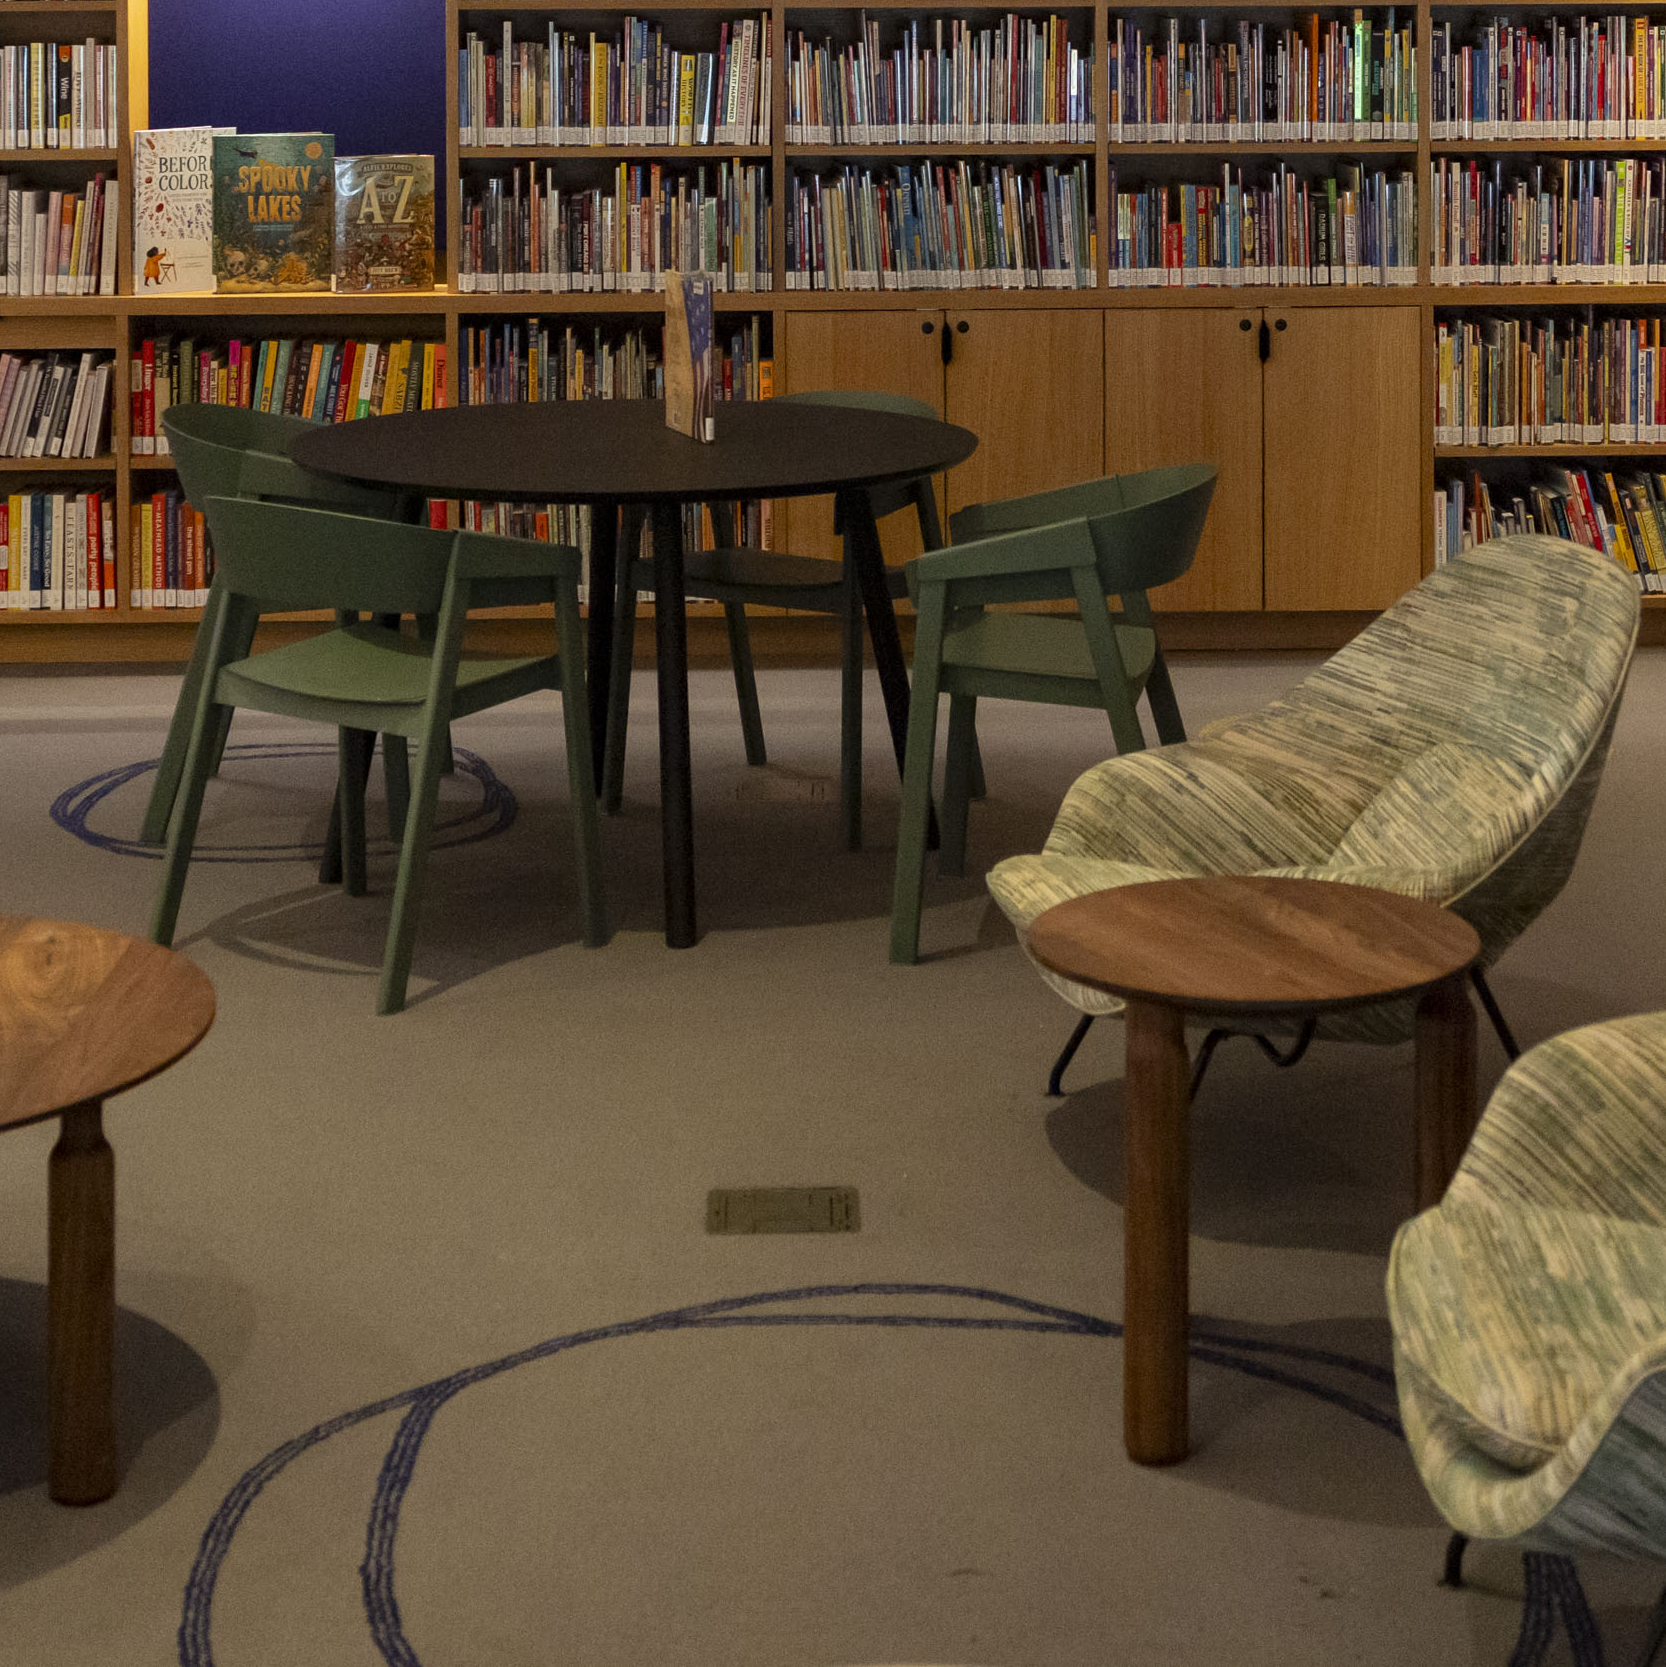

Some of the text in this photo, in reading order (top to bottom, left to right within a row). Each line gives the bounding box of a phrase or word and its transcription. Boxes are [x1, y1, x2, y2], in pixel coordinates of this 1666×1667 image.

[732, 41, 740, 68] HISTORY
[732, 69, 738, 78] AS
[60, 77, 69, 99] Wine
[729, 86, 737, 120] HAPPENED
[238, 166, 312, 193] SPOOKY
[247, 195, 302, 223] LAKES
[89, 536, 98, 590] party people
